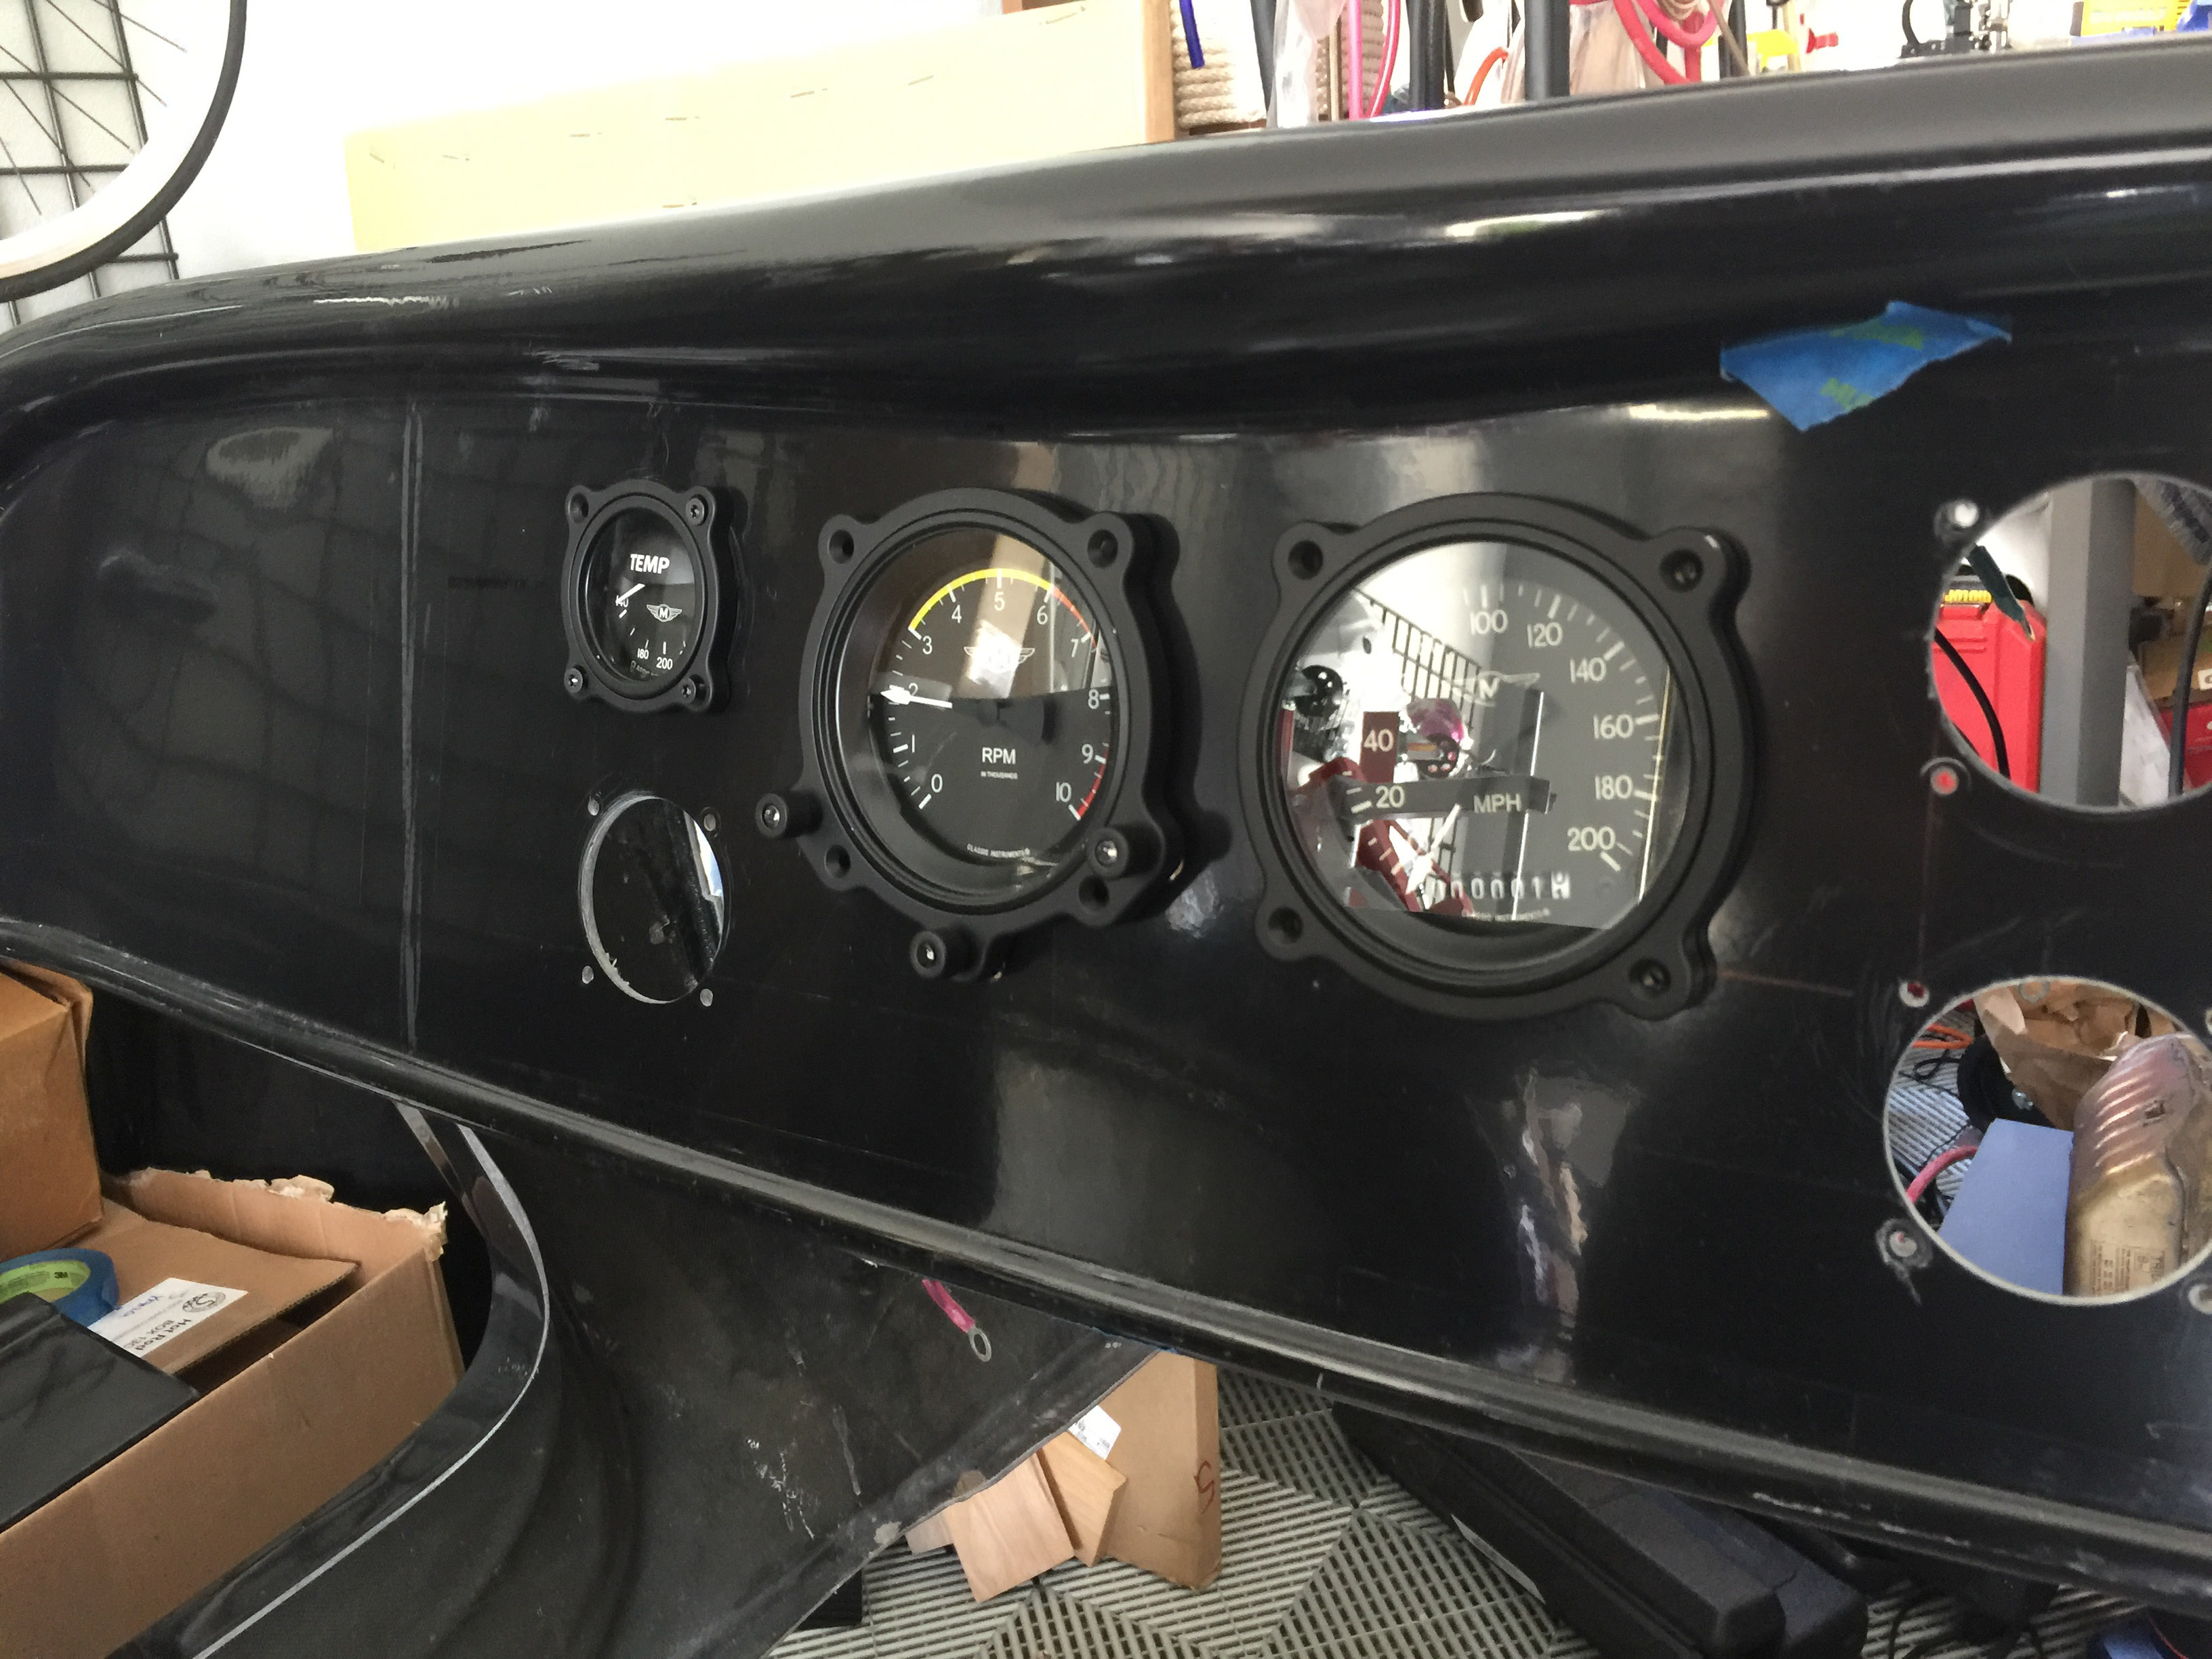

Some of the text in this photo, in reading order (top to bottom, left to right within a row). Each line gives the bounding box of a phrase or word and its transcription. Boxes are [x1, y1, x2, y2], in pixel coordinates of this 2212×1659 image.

[630, 554, 670, 574] TEMP
[994, 592, 1005, 611] 5
[951, 605, 962, 623] 4
[1037, 605, 1048, 625] 6
[1470, 609, 1509, 636] 100
[1527, 621, 1563, 649] 120
[638, 648, 649, 659] 180
[922, 636, 933, 655] 3
[1071, 638, 1079, 657] 7
[656, 657, 673, 670] 200
[1570, 657, 1607, 684] 140
[1088, 689, 1100, 710] 8
[1593, 714, 1634, 739] 160
[912, 734, 915, 753] 1
[1364, 729, 1394, 753] 40
[982, 747, 1016, 764] RPM
[1082, 743, 1094, 764] 9
[931, 774, 943, 792] 0
[1056, 781, 1072, 802] 10
[1595, 775, 1633, 800] 180
[1375, 785, 1406, 808] 20
[1473, 793, 1522, 813] MPH
[1567, 825, 1616, 851] 200
